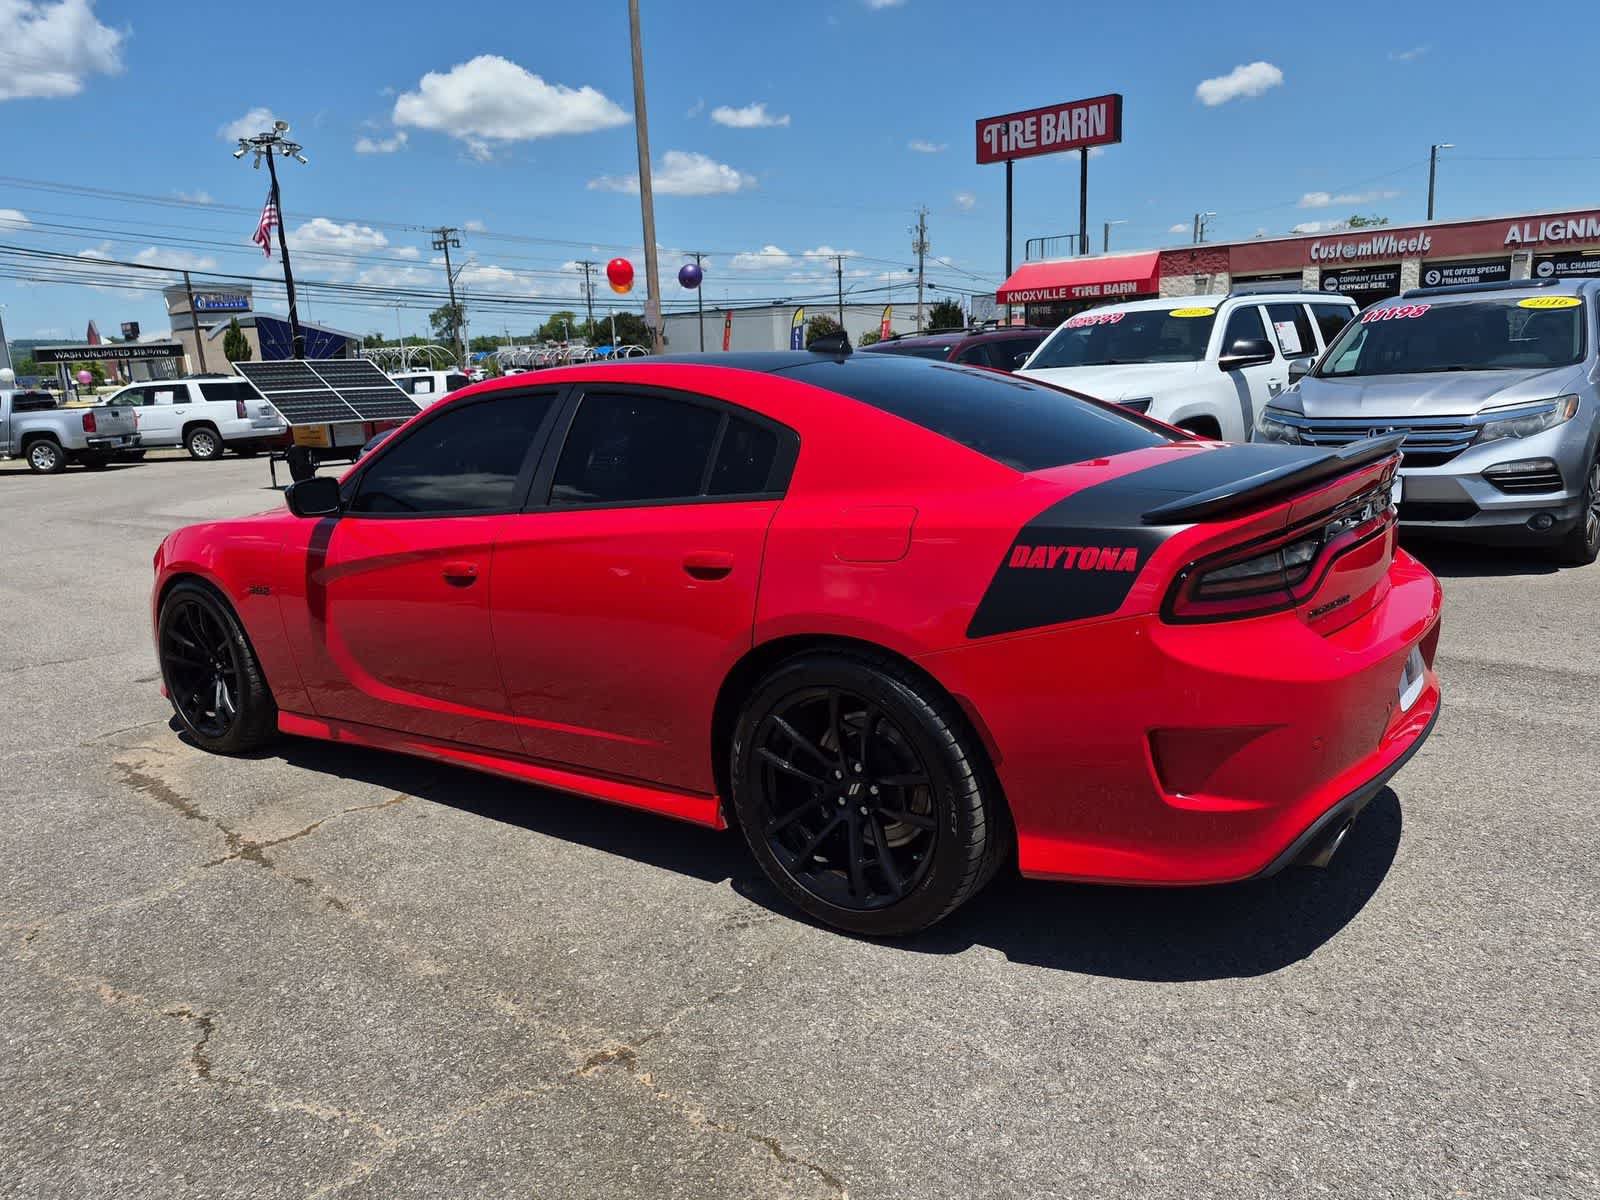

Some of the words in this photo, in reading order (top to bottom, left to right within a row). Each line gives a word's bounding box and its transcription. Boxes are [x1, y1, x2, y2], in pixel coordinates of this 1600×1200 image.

[1040, 103, 1106, 146] BARN
[1454, 267, 1476, 276] OFFER
[1477, 265, 1507, 274] SPECIAL
[1339, 274, 1370, 283] COMPANY
[1370, 273, 1396, 281] FLEETS
[1441, 276, 1480, 285] FINANCING
[1007, 288, 1067, 302] KNOXVILLE
[1103, 282, 1137, 295] BARN
[1527, 298, 1569, 307] 2016
[55, 351, 82, 360] WASH
[83, 349, 131, 359] UNLIMITED
[1008, 545, 1139, 572] DAYTONA
